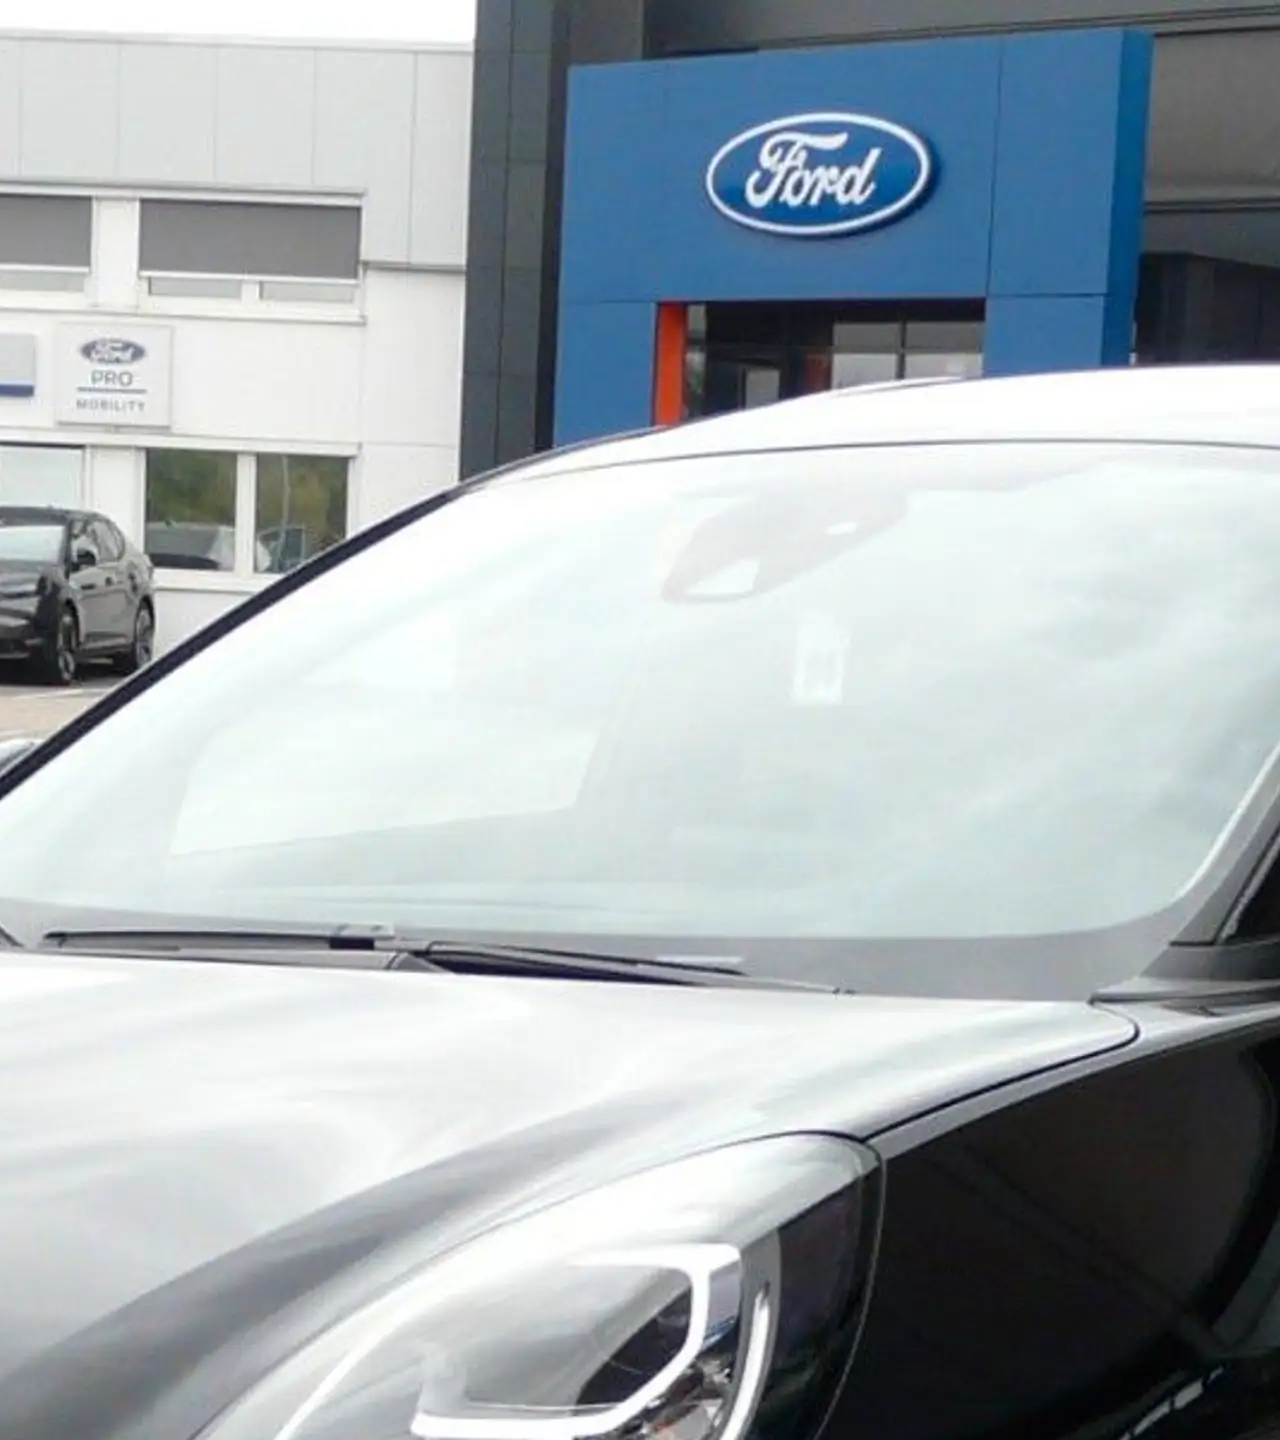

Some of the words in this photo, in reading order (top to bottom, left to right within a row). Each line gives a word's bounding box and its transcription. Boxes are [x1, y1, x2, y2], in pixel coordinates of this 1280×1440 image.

[744, 131, 882, 208] Ford
[90, 370, 134, 387] PRO
[76, 399, 146, 412] MOBILITY
